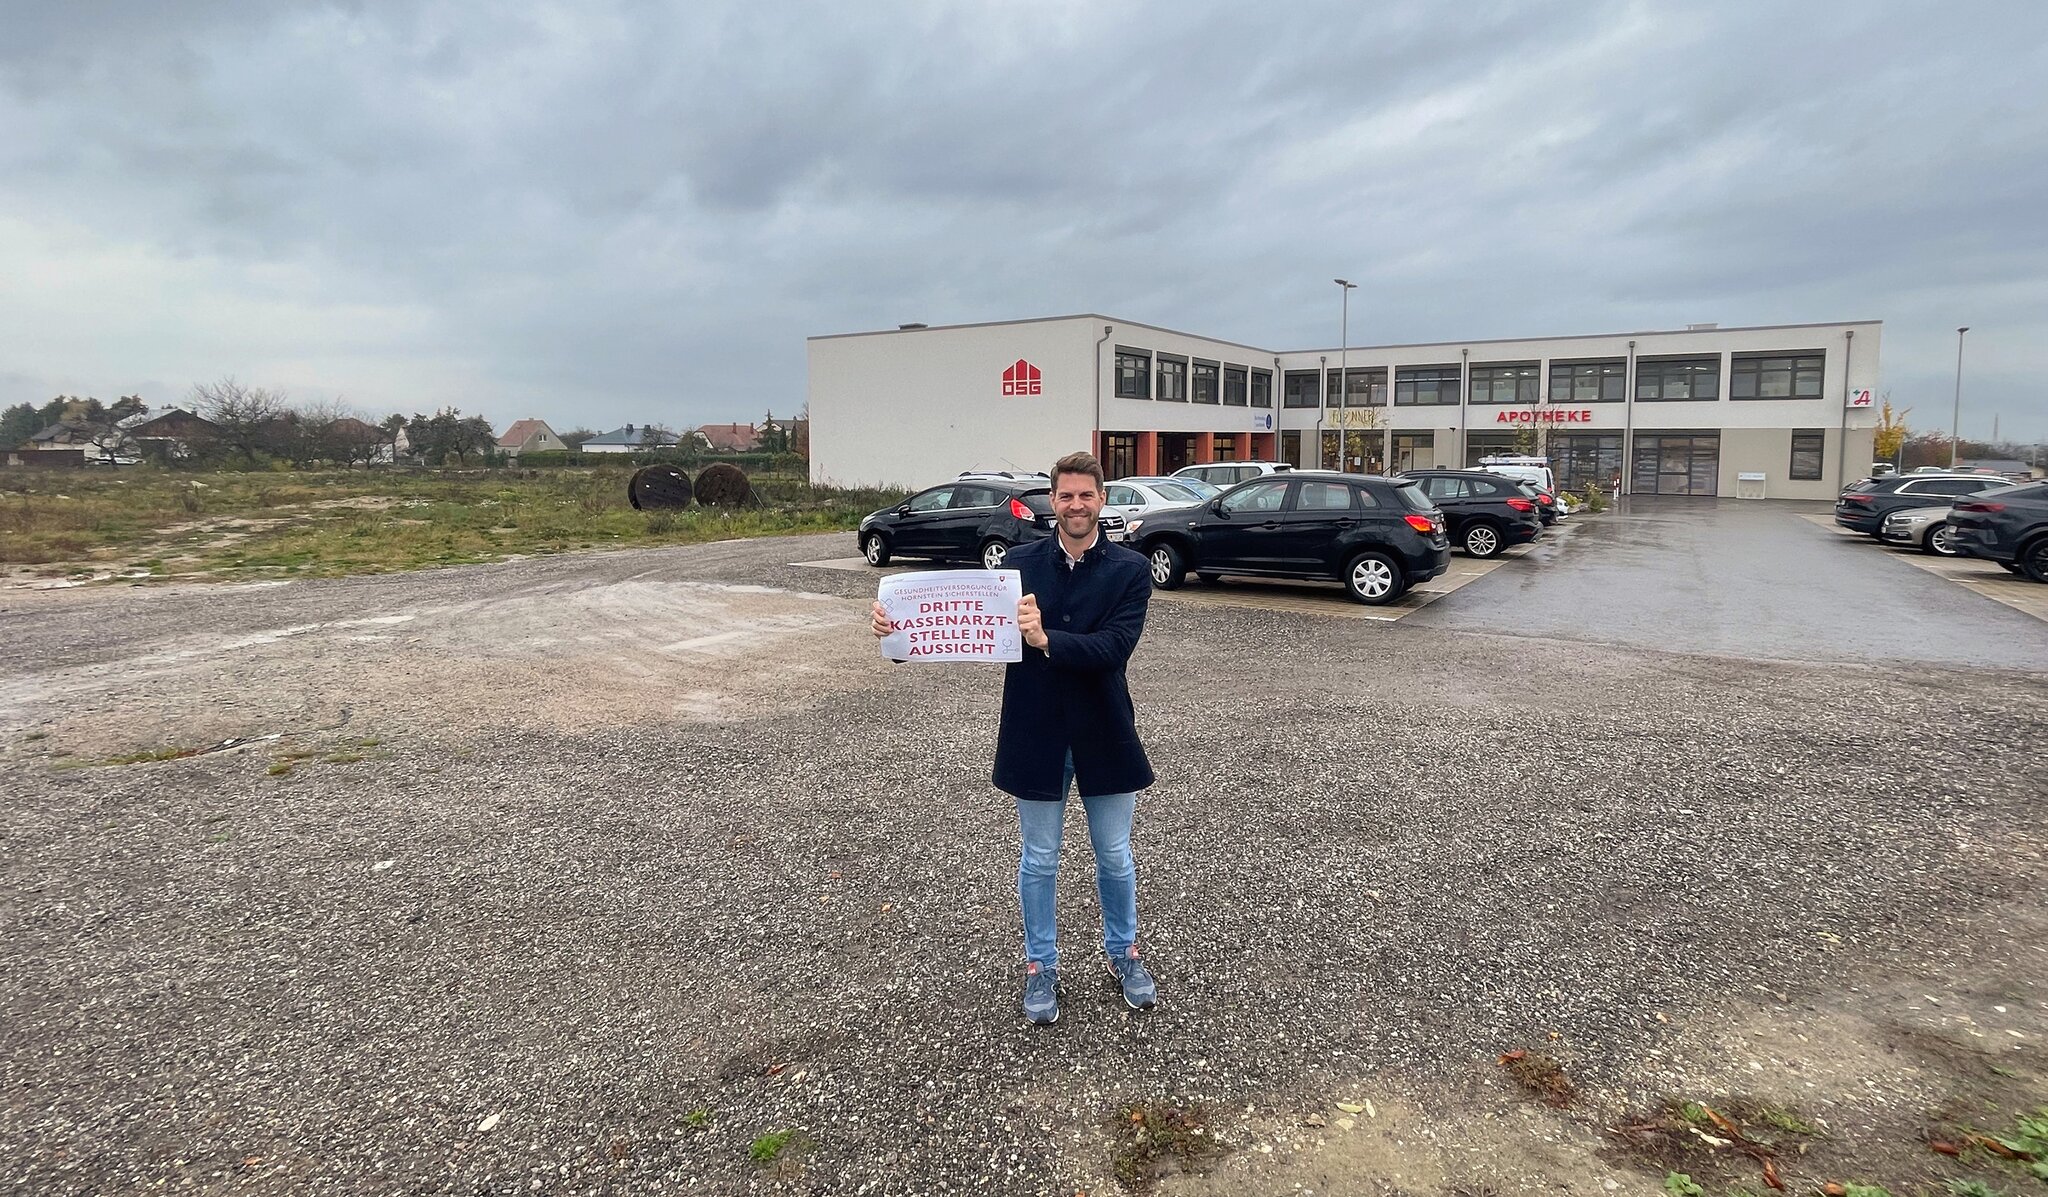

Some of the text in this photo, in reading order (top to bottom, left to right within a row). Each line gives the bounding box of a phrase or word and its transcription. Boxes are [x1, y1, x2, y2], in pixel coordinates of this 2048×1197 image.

[1003, 381, 1041, 396] OSG
[1496, 410, 1592, 423] APOTHEKE
[894, 584, 1008, 596] GESUNDHEITSVERSORGUNG FÜR
[901, 592, 943, 601] HORNSTEIN
[920, 600, 984, 614] DRITTE
[890, 615, 1013, 631] KASSENARZT-
[909, 629, 994, 643] STELLE IN
[909, 643, 996, 656] AUSSICHT
